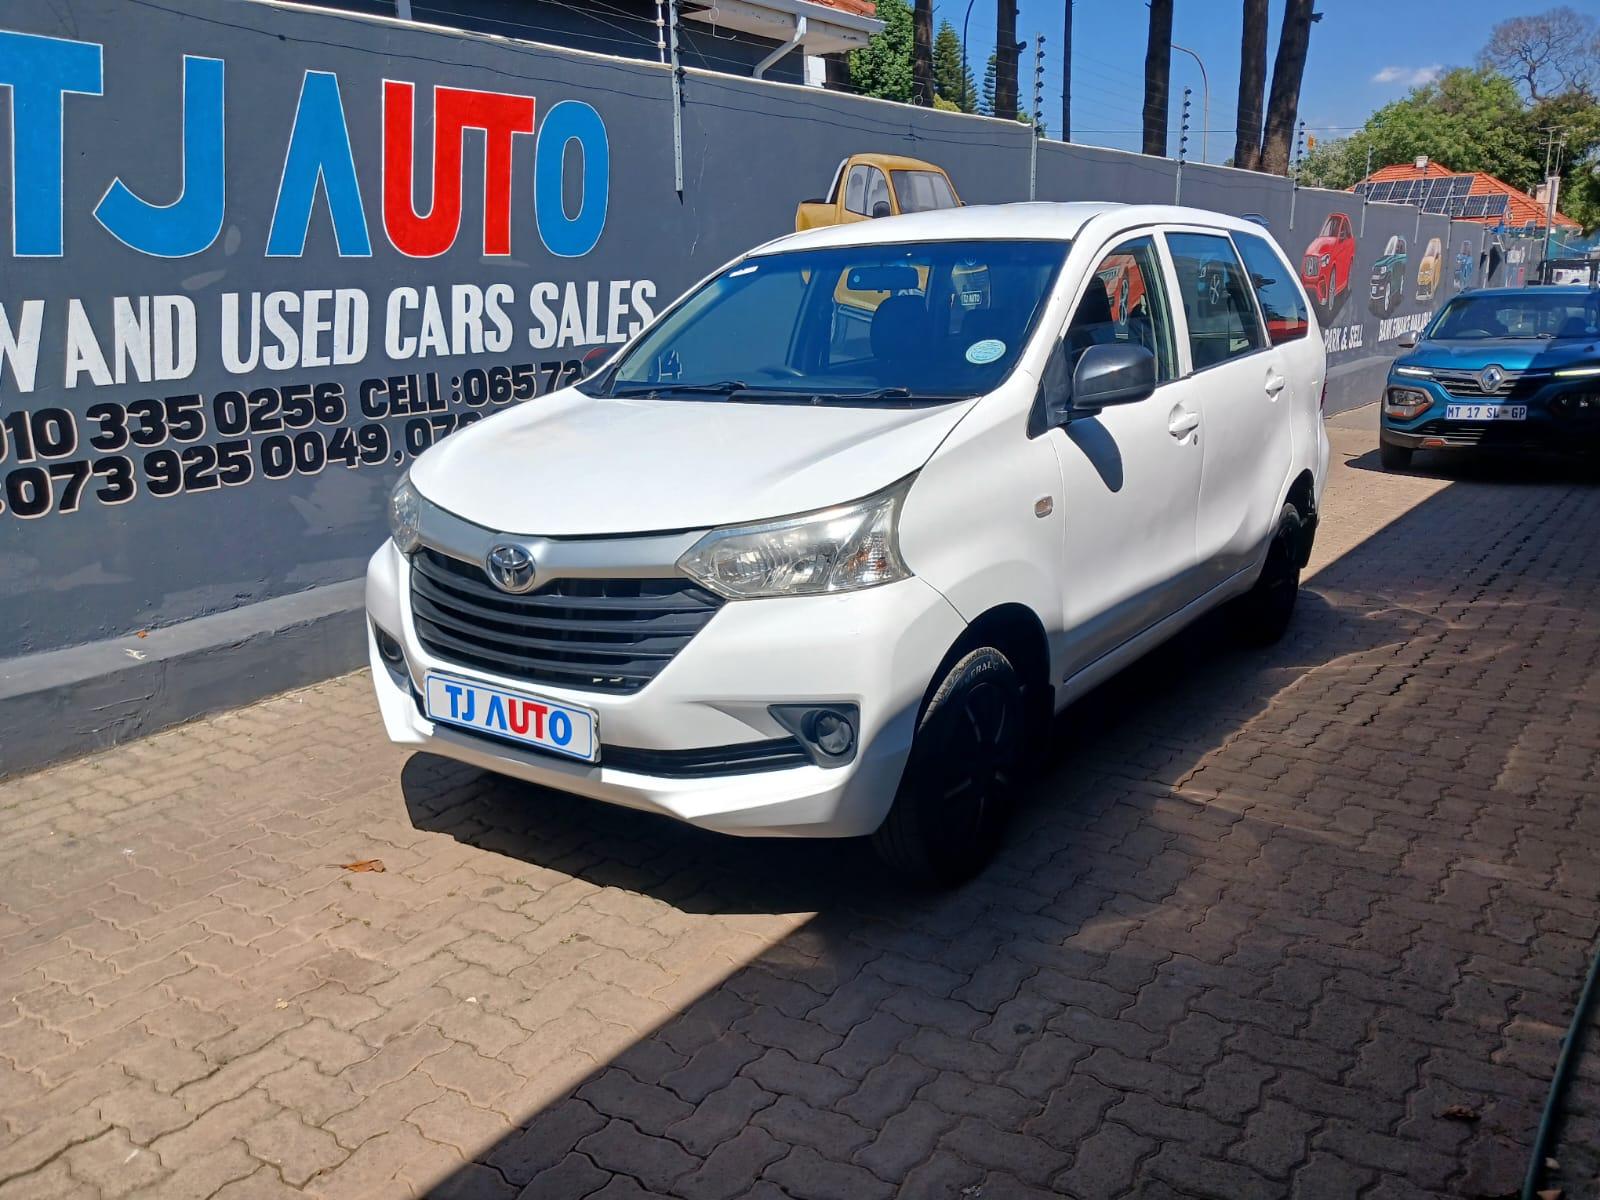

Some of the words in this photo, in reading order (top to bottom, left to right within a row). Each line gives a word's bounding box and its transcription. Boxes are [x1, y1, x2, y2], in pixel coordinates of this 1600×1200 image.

[0, 29, 225, 258] TJ
[265, 70, 609, 258] AUTO
[65, 295, 197, 389] AND
[221, 288, 369, 374] USED
[385, 283, 515, 360] CARS
[529, 280, 657, 349] SALES
[1324, 327, 1341, 353] PARK
[1341, 326, 1348, 351] &
[1348, 324, 1363, 349] SELL
[0, 407, 78, 465] 10
[86, 394, 206, 453] 335
[213, 382, 347, 437] 0256
[359, 372, 448, 420] CELL
[1447, 407, 1461, 418] MT
[1467, 407, 1480, 418] 17
[1487, 407, 1500, 418] SL
[1511, 407, 1526, 418] GP
[0, 455, 136, 519] 073
[144, 438, 254, 498] 925
[445, 684, 475, 721] TJ
[485, 695, 572, 746] AUTO
